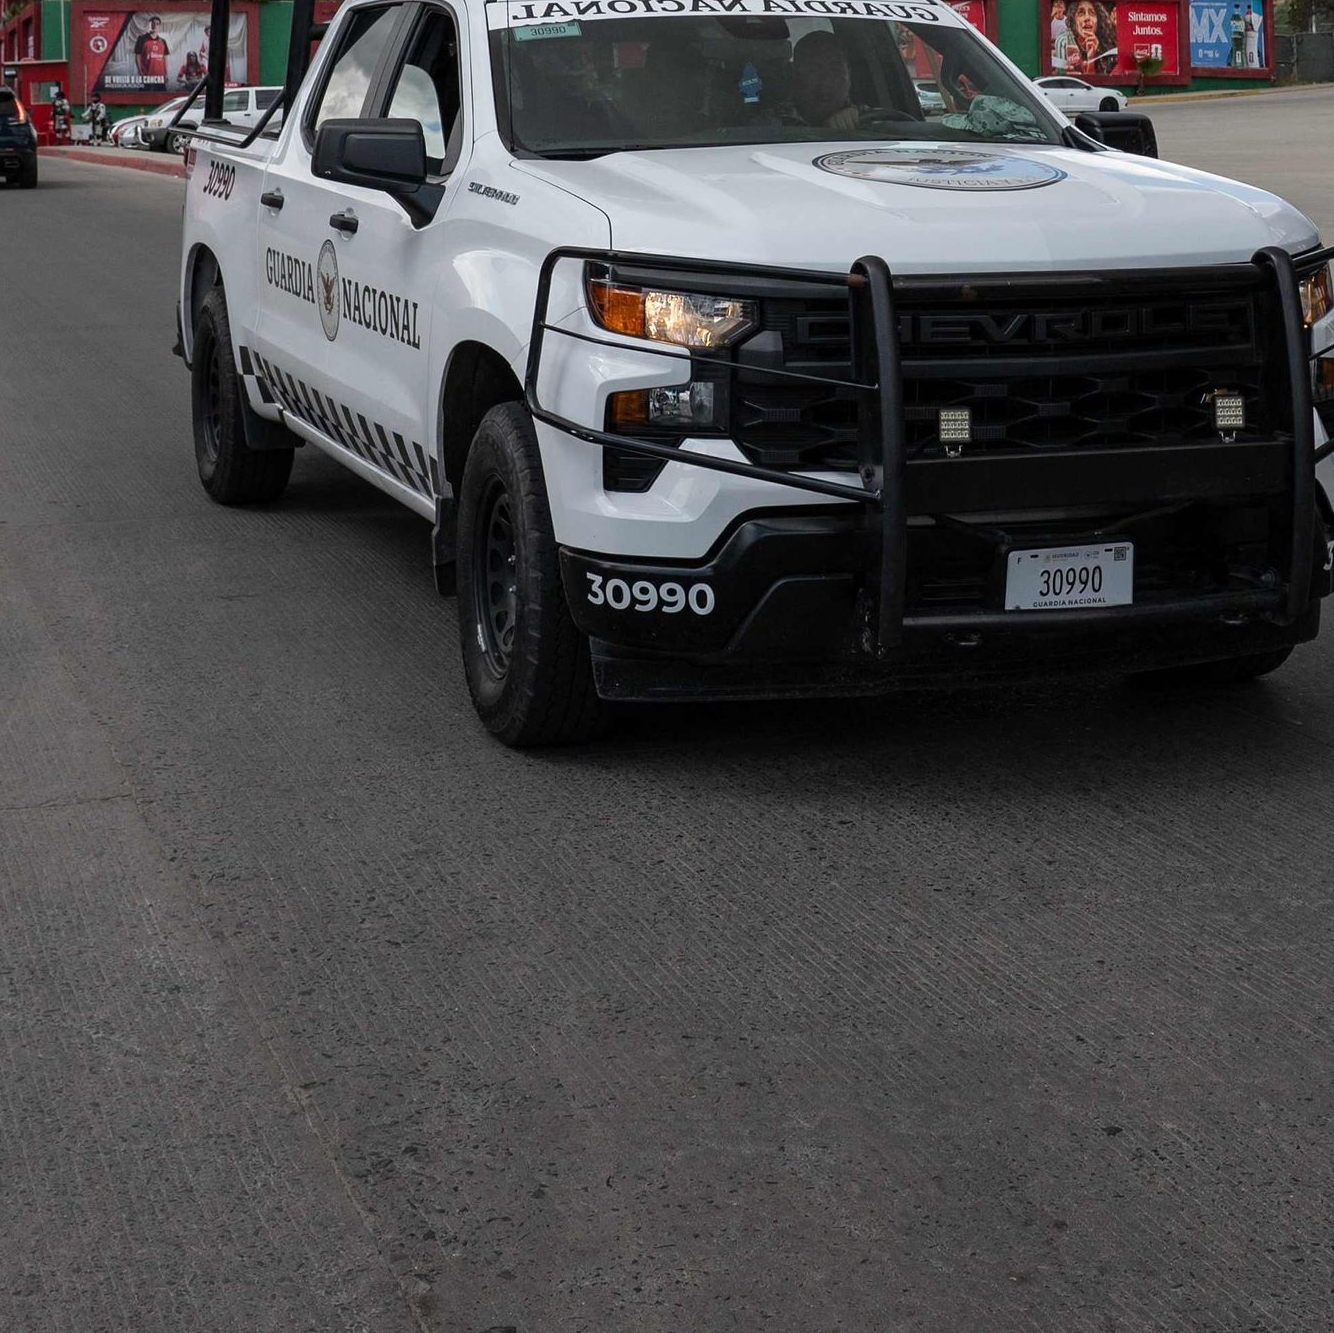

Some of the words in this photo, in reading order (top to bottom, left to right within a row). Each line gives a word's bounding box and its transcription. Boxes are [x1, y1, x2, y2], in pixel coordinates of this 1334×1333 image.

[530, 26, 567, 37] 30990
[1128, 11, 1167, 22] Sintamos
[1132, 24, 1163, 35] Juntos.
[1189, 7, 1228, 44] MX
[203, 160, 235, 201] 30990
[266, 247, 315, 304] GUARDIA
[342, 277, 420, 350] NACIONAL
[586, 572, 715, 616] 30990
[1039, 565, 1102, 597] 30990
[1033, 600, 1066, 608] GUARDIA
[1068, 597, 1107, 606] NACIONAL
